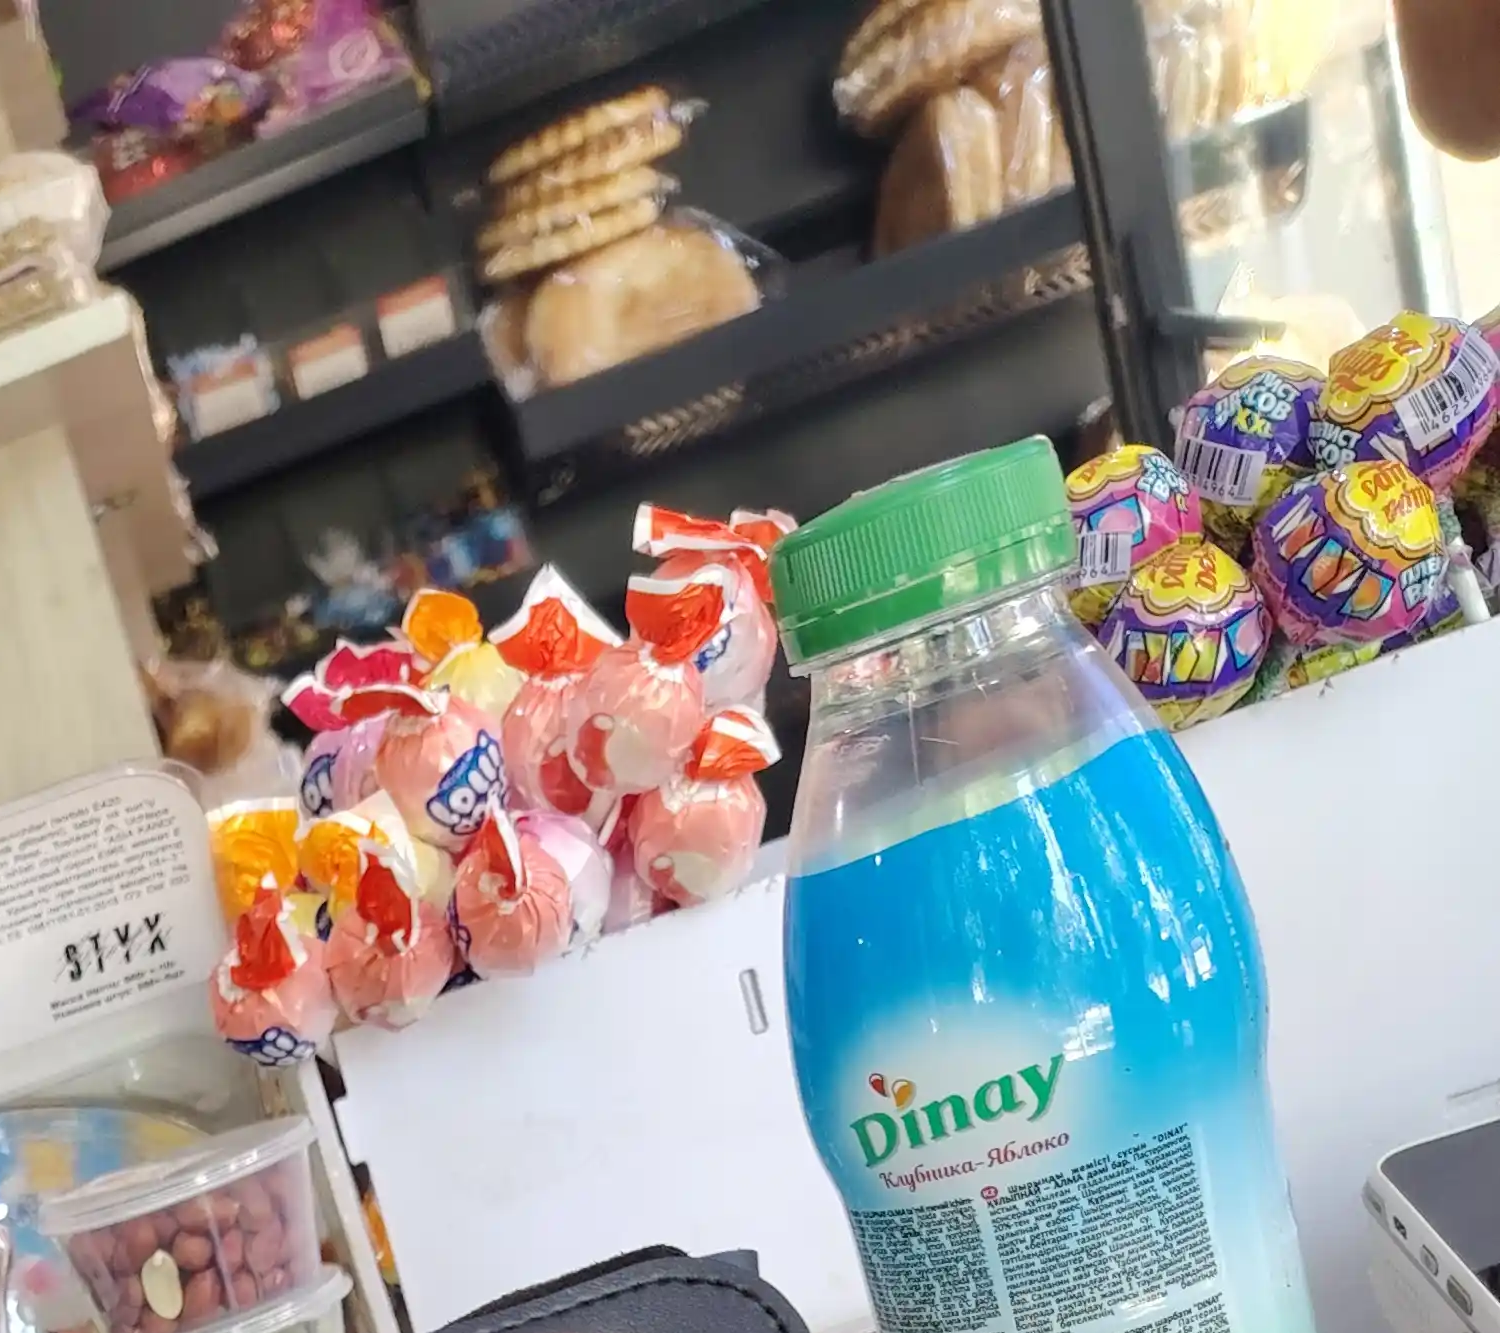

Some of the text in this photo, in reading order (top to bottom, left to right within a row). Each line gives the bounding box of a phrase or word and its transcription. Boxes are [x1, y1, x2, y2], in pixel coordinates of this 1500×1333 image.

[58, 911, 172, 982] STYX
[850, 1054, 1063, 1168] Dinay
[879, 1131, 1070, 1192] Клубника-Яблоко
